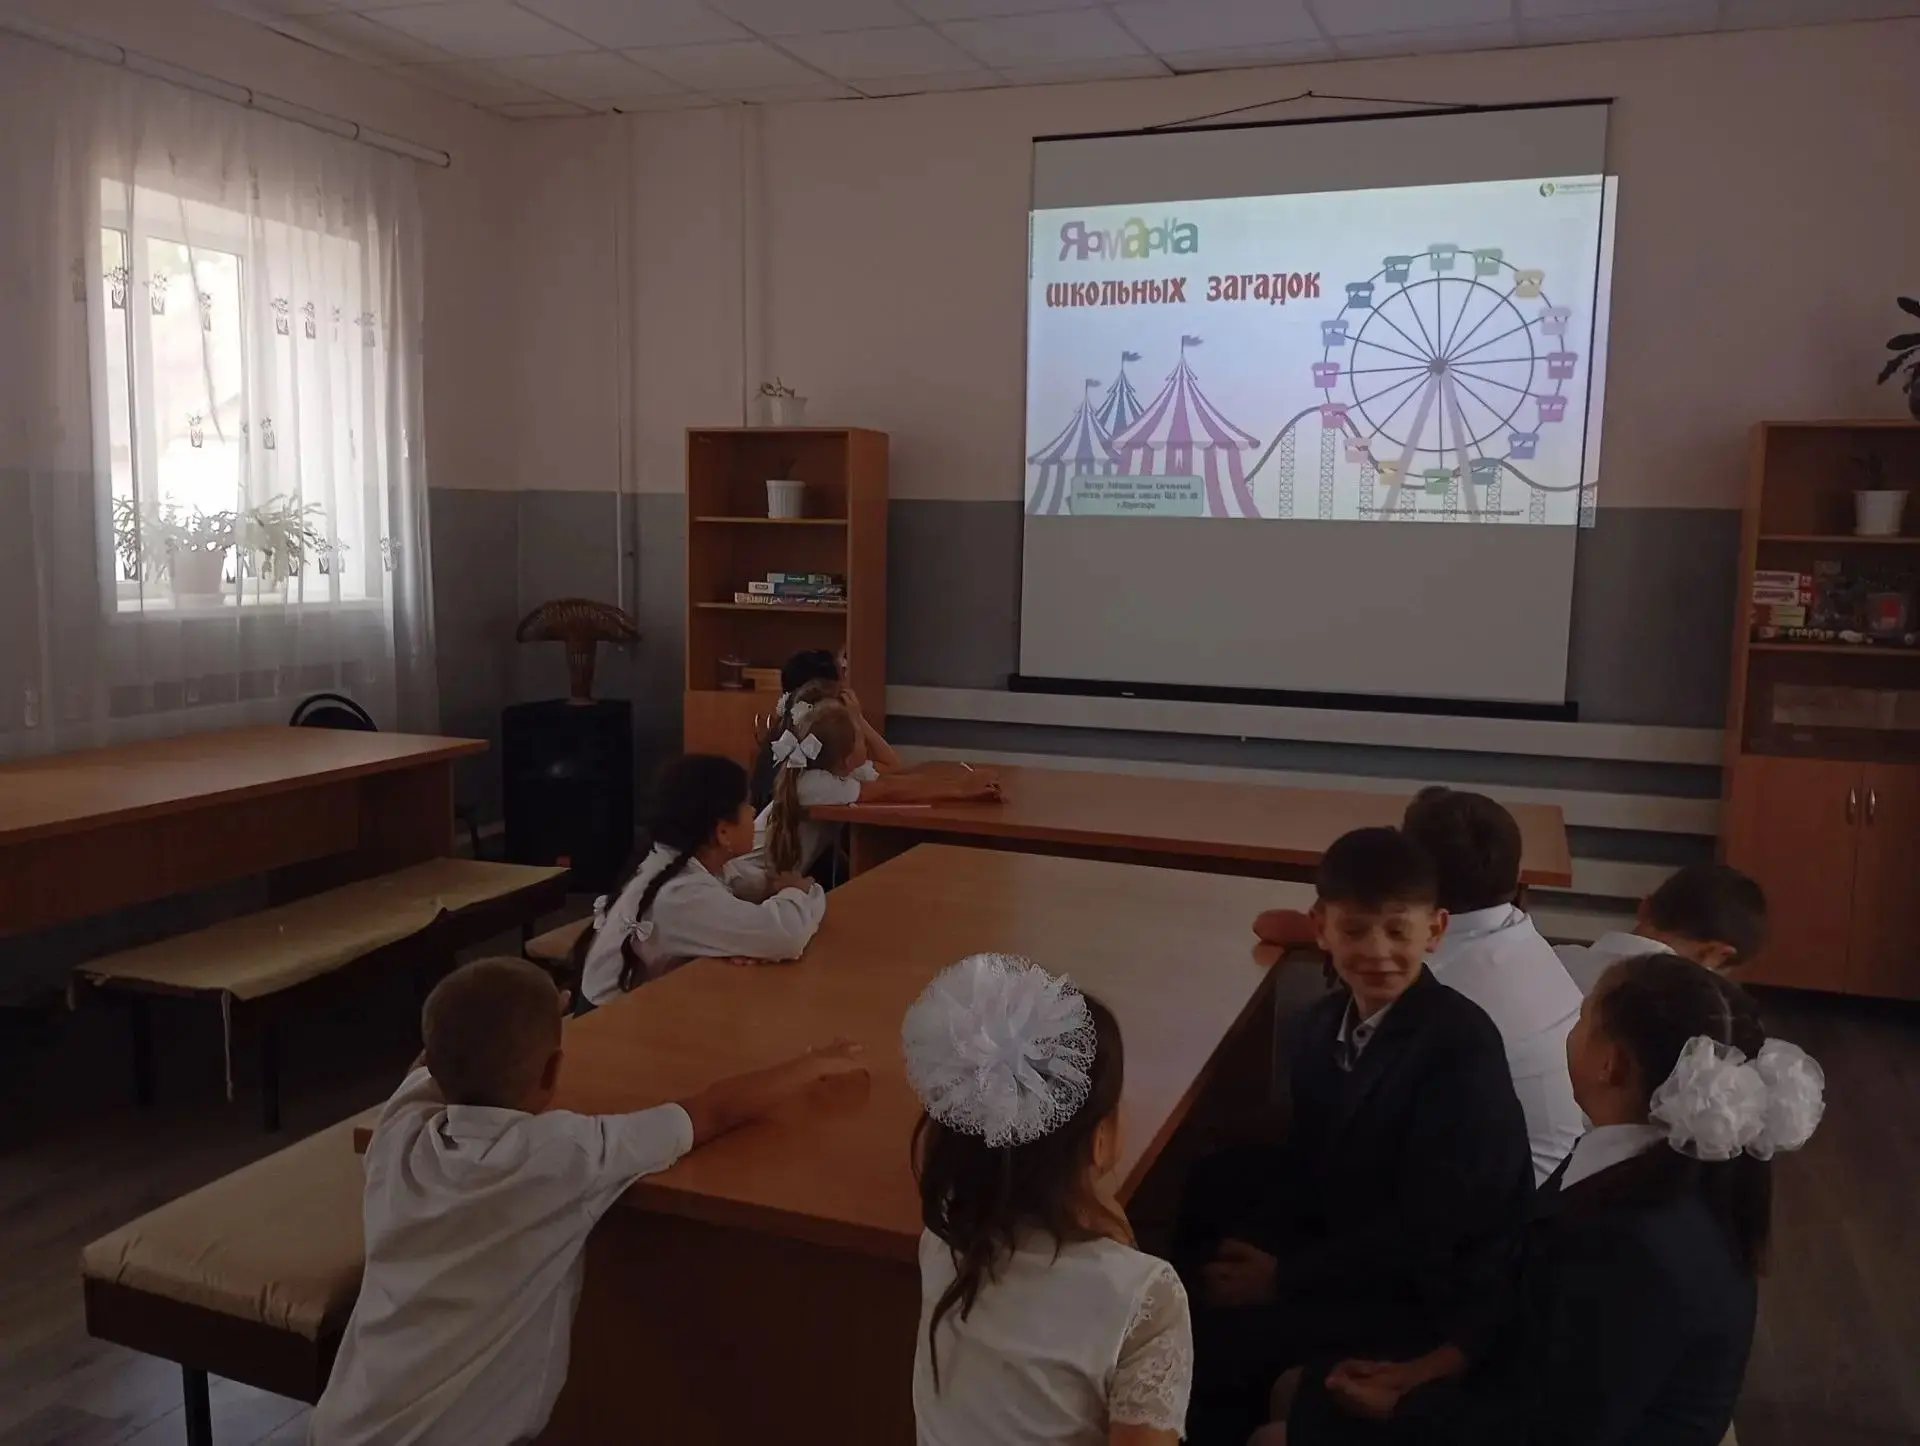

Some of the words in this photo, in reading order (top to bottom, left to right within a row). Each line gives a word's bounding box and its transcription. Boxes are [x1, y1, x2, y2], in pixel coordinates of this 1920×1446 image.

[1058, 215, 1199, 262] Ярмарка
[1045, 276, 1188, 308] школьных
[1206, 271, 1321, 306] загадок
